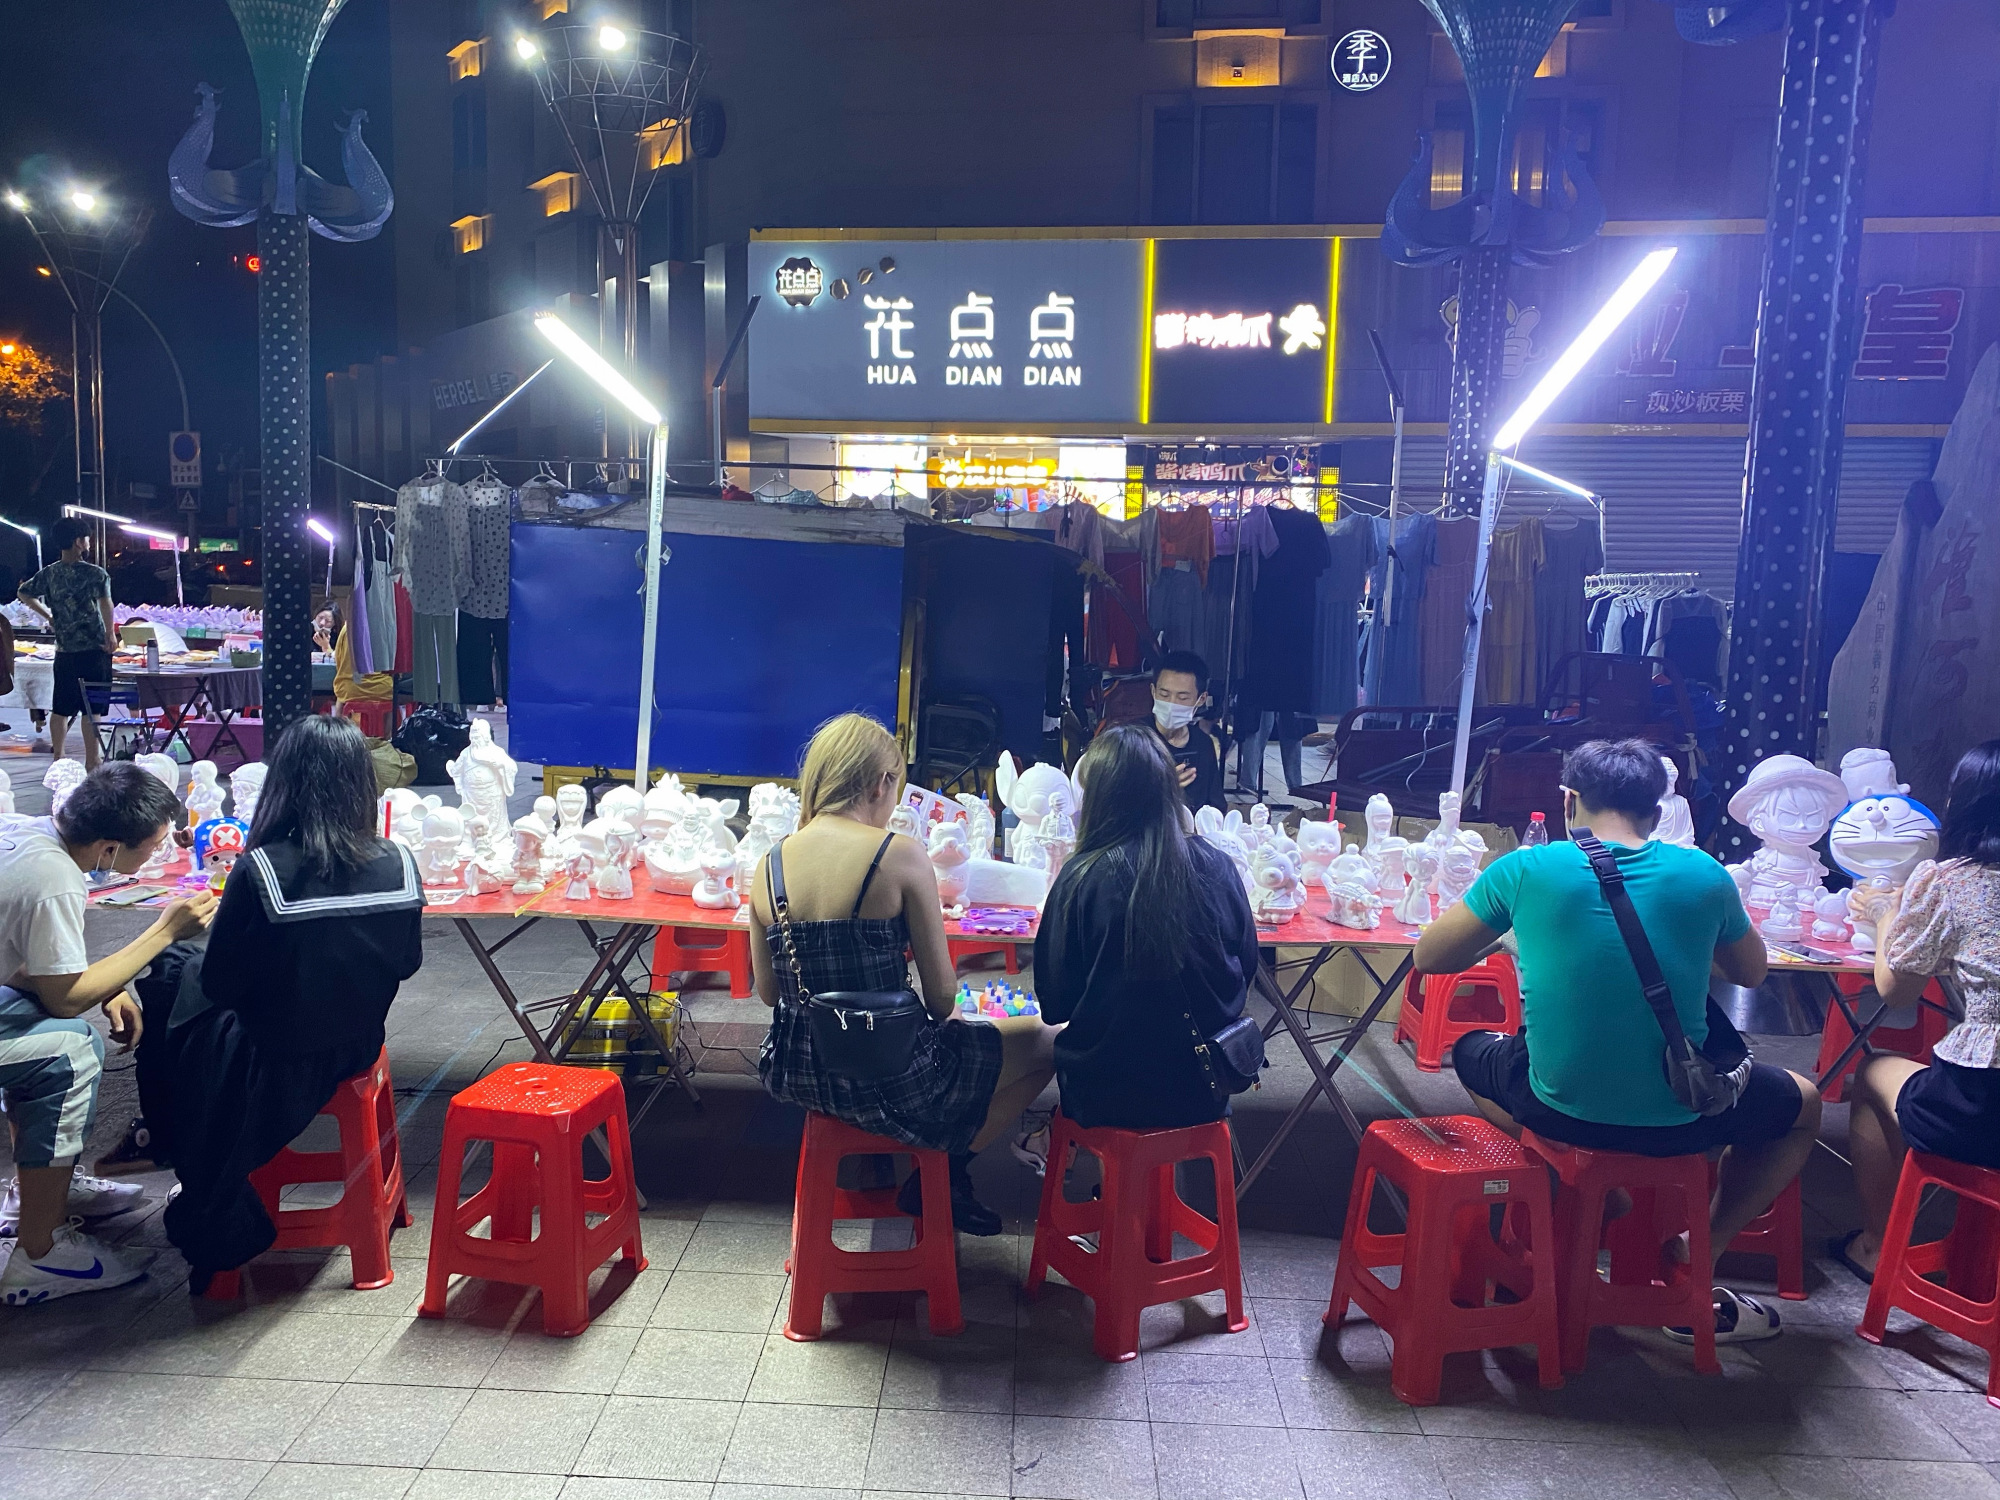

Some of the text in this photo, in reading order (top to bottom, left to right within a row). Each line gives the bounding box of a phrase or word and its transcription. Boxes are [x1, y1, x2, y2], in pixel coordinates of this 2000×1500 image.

[1346, 34, 1378, 73] 季
[779, 268, 820, 289] 花点点
[863, 291, 1075, 359] 花点点
[867, 365, 1081, 386] HUA DIAN DIAN
[1646, 391, 1746, 414] 现炒板栗
